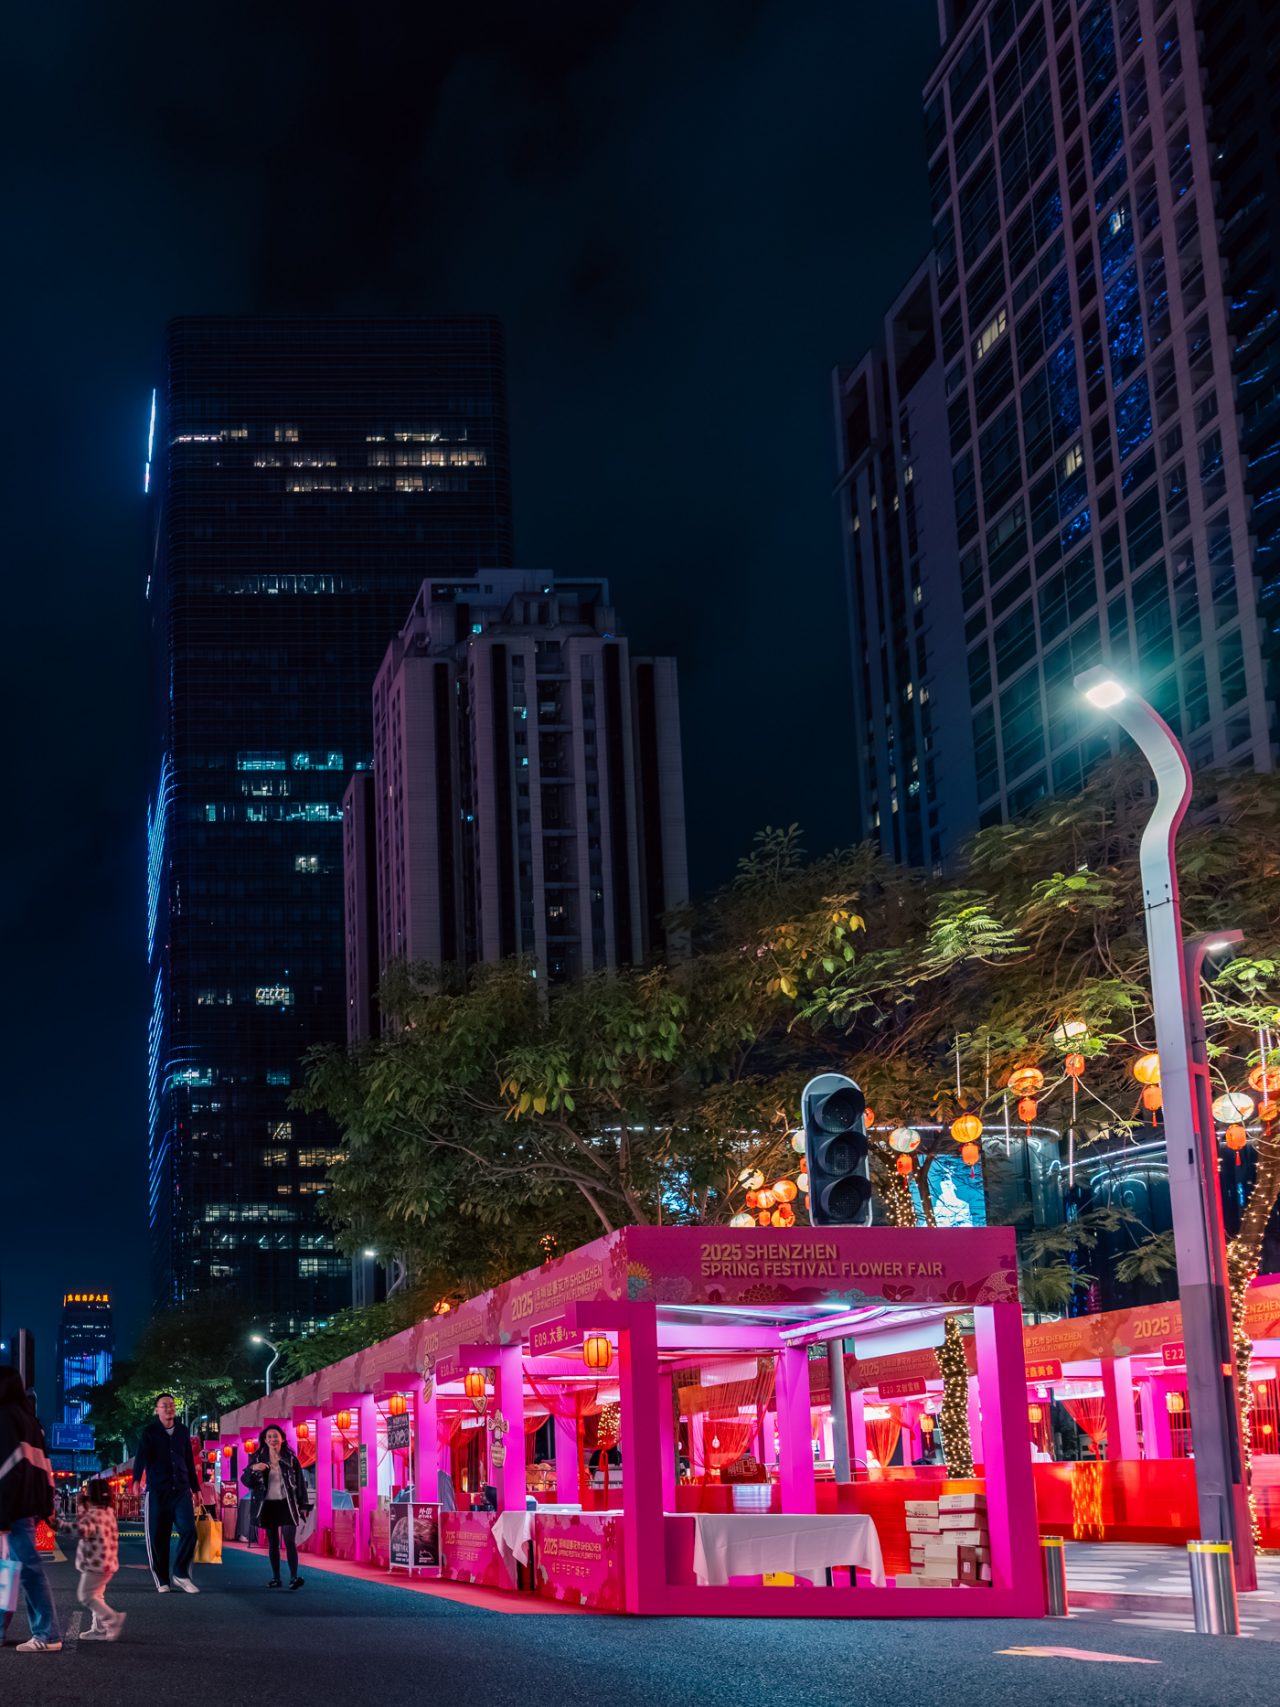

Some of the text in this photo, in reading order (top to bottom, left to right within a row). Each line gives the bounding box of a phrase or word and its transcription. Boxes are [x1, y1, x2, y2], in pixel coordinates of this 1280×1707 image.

[700, 1244, 837, 1260] 2025 SHENZHEN
[570, 1264, 603, 1287] SHENZHEN
[700, 1262, 943, 1276] SPRING FESTIVAL FLOWER FAIR
[512, 1290, 534, 1322] 2025
[1134, 1317, 1169, 1338] 2025
[1045, 1332, 1082, 1345] SHENZHEN
[1165, 1349, 1184, 1361] E22
[860, 1362, 880, 1377] 2025
[543, 1537, 558, 1555] 2025
